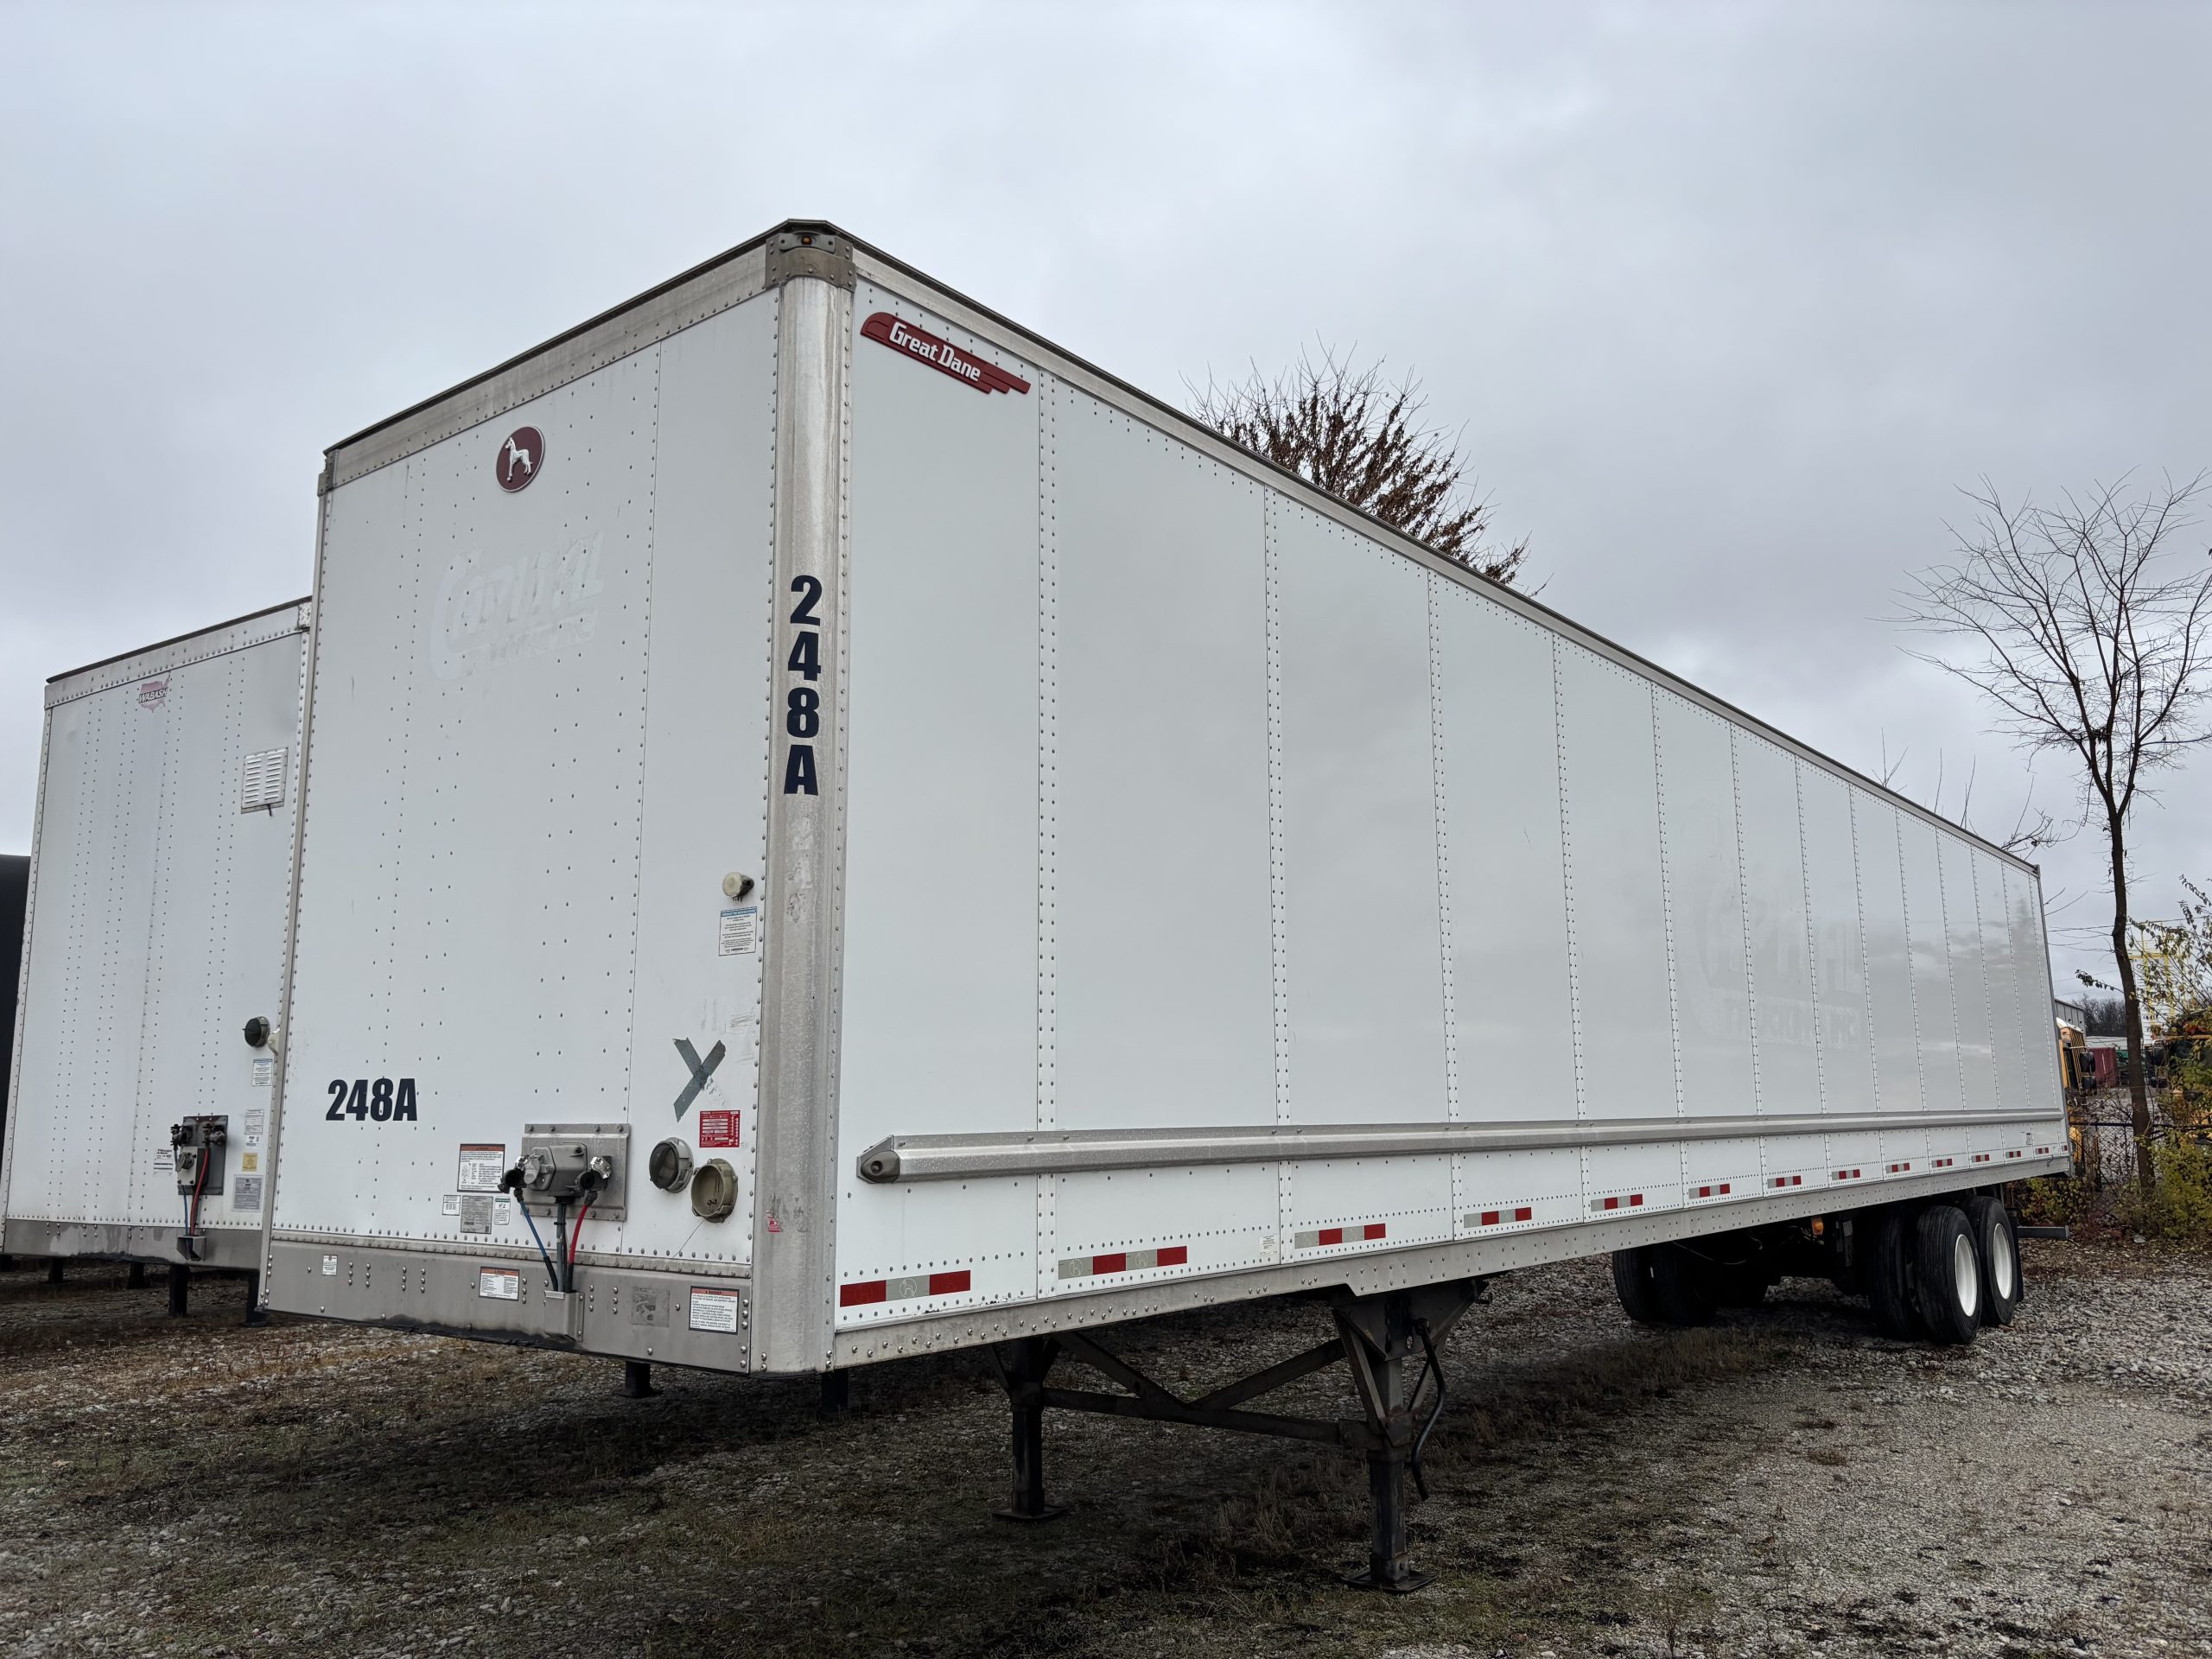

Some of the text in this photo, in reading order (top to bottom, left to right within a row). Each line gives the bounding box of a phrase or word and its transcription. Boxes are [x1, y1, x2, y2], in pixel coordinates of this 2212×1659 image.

[888, 321, 982, 383] Great Dane
[138, 687, 168, 704] WABASH
[783, 574, 823, 797] 248A
[325, 1077, 418, 1122] 248A
